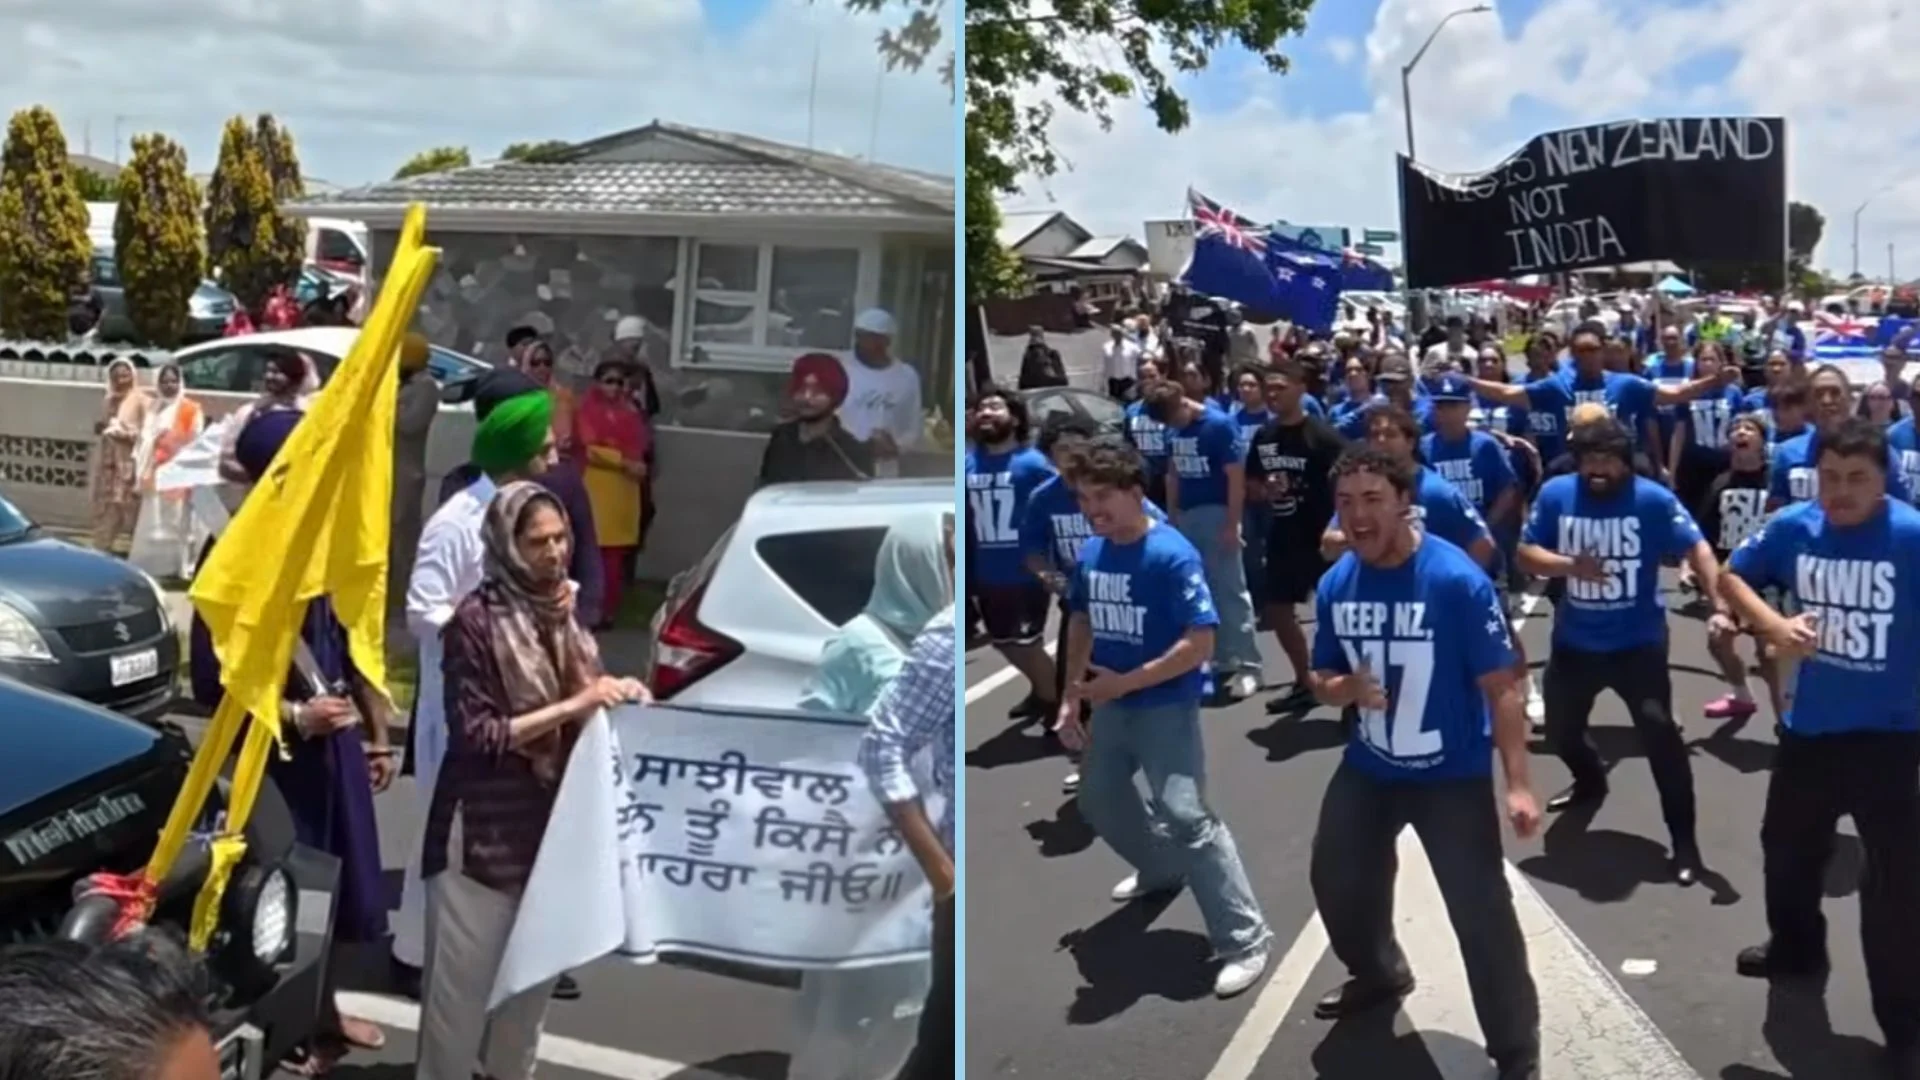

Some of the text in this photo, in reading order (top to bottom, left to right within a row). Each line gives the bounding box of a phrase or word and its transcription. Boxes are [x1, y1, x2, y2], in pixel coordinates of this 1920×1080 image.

[1542, 126, 1605, 176] NEW
[1608, 118, 1773, 167] ZEALAND
[1509, 183, 1569, 224] NOT
[1504, 214, 1626, 271] INDIA
[969, 489, 1019, 542] NZ
[1559, 516, 1641, 557] KIWIS
[1089, 571, 1132, 602] TRUE
[1797, 554, 1895, 611] KIWIS
[1332, 602, 1434, 640] KEEP NZ,
[1803, 604, 1893, 660] IRST
[1340, 639, 1443, 757] NZ
[633, 750, 854, 805] ਸਾਝੀਵਾਲ
[754, 806, 856, 856] ਕਿਸੈ
